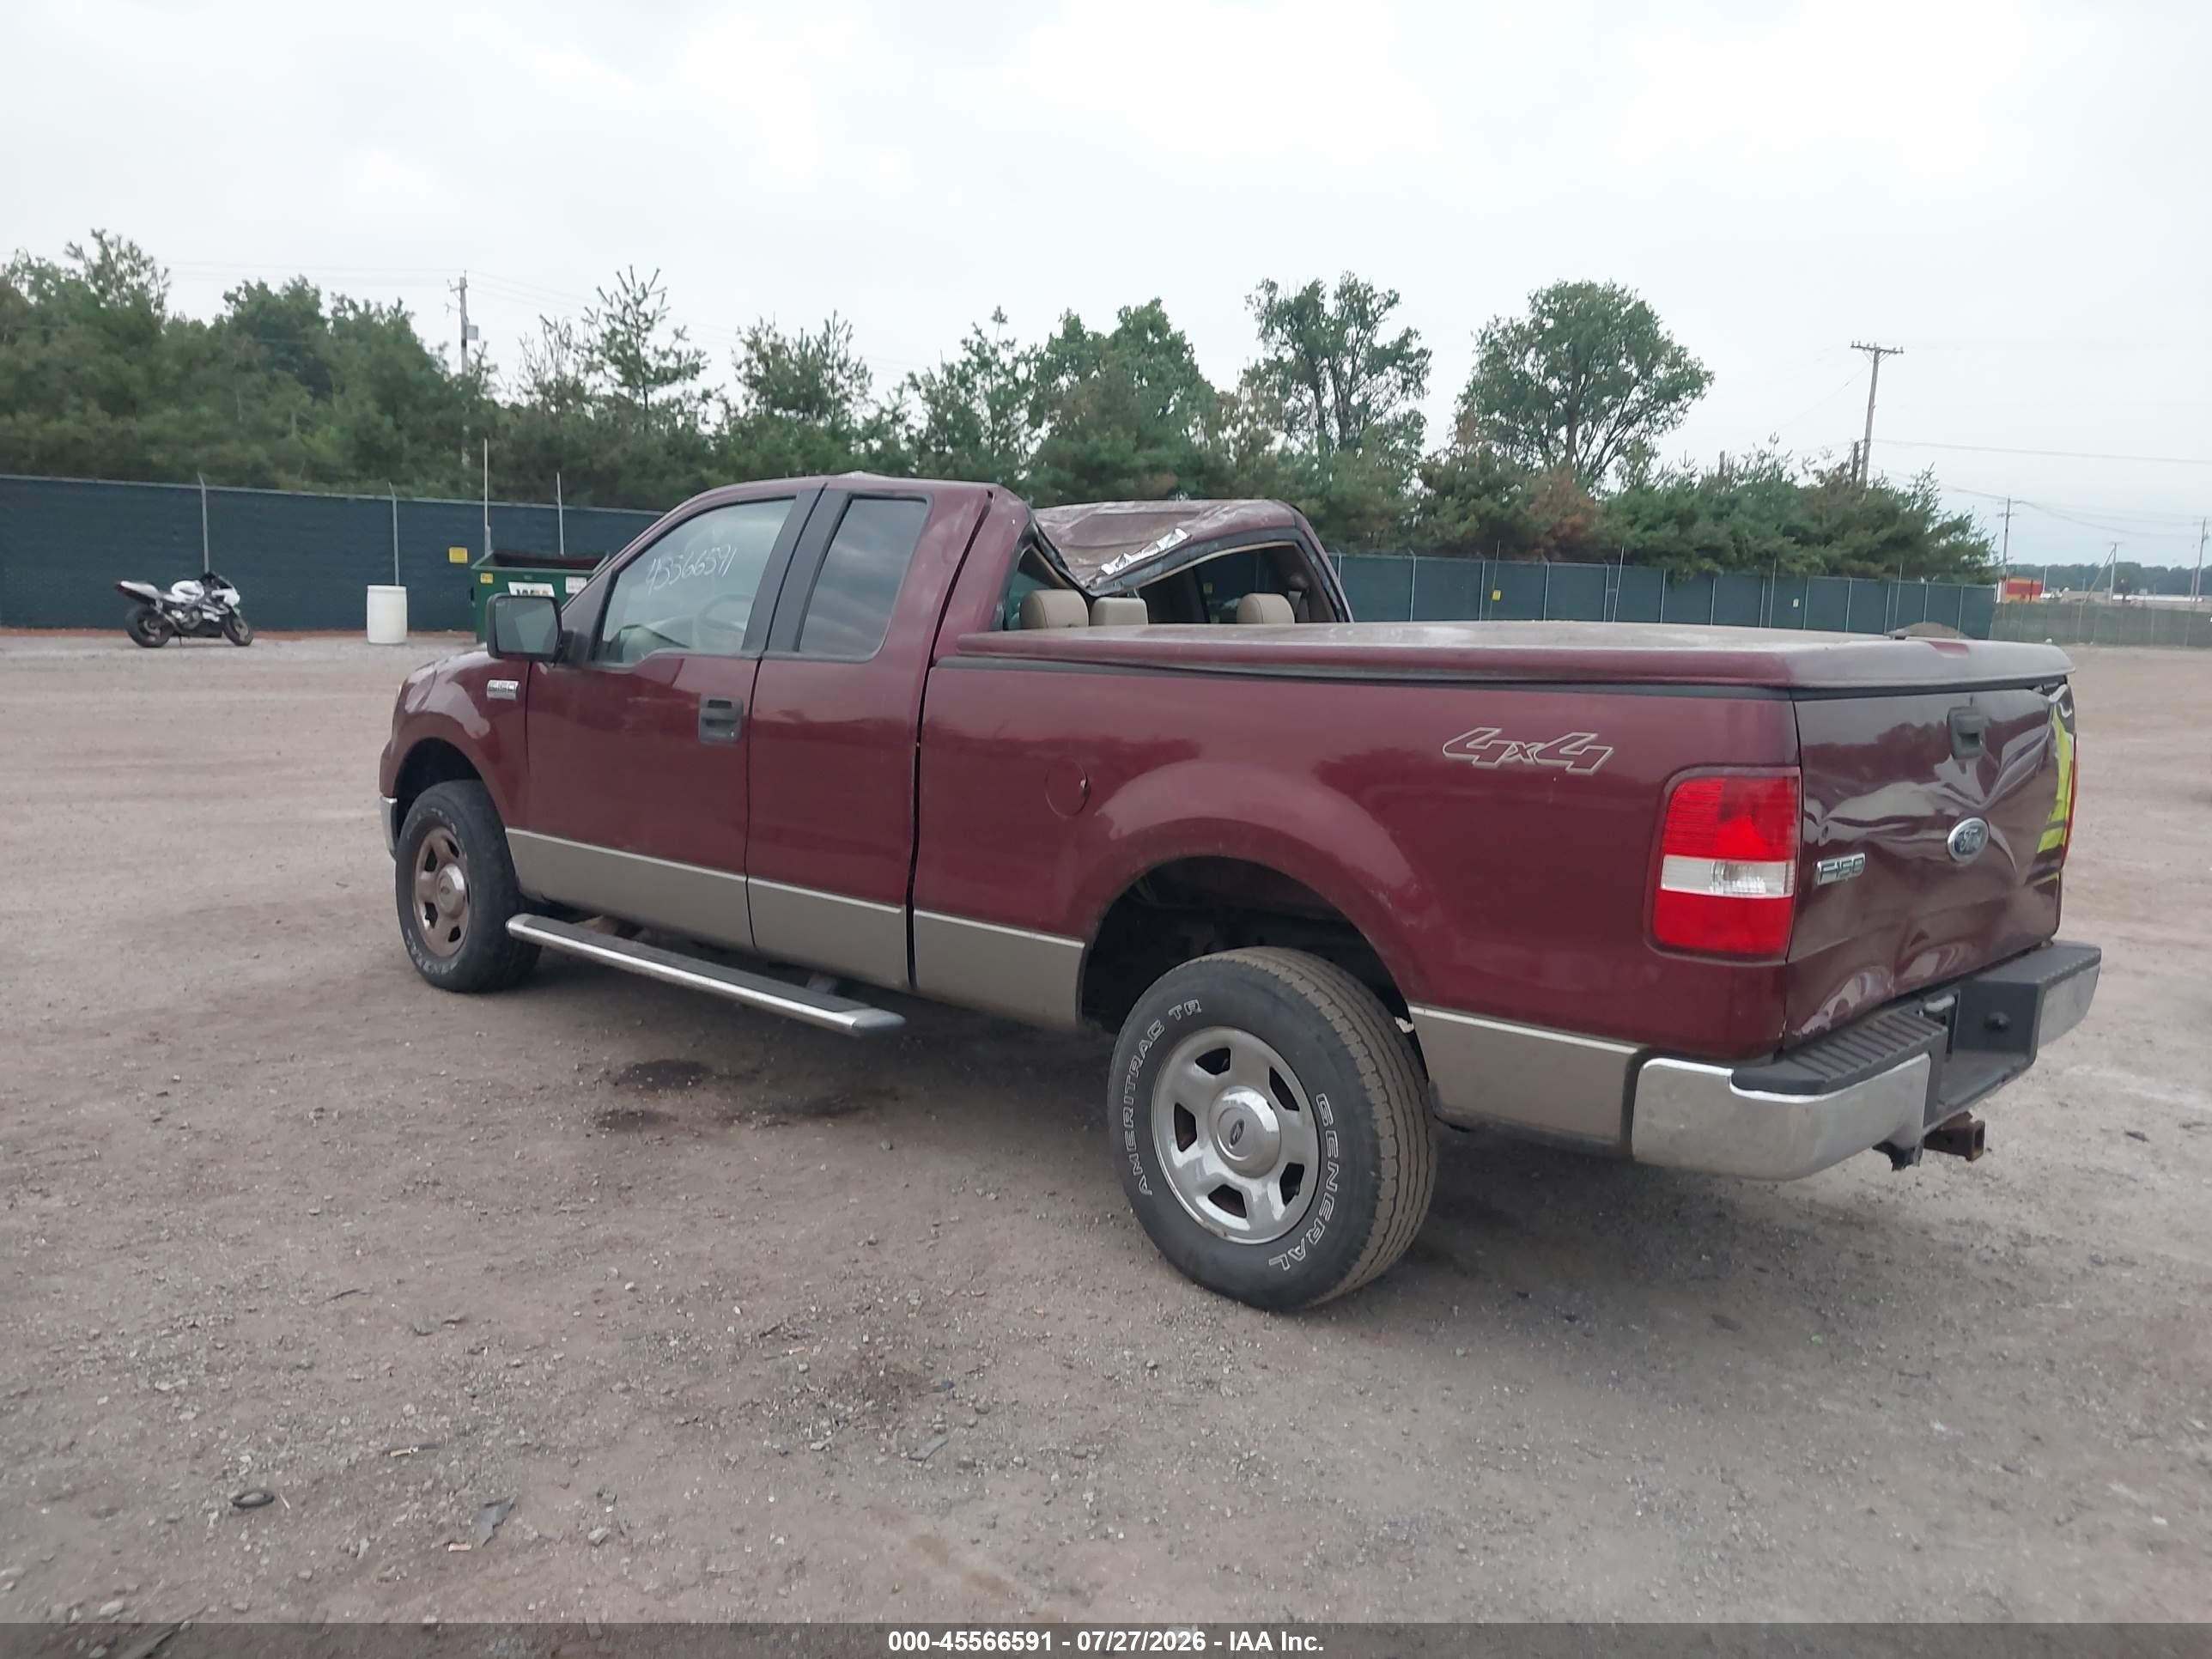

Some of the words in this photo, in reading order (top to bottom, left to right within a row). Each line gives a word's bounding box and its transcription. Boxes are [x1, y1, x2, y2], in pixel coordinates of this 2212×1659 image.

[1442, 726, 1615, 776] 4x4
[1122, 1019, 1165, 1196] AMERITRAC
[1268, 1092, 1340, 1272] GENERAL
